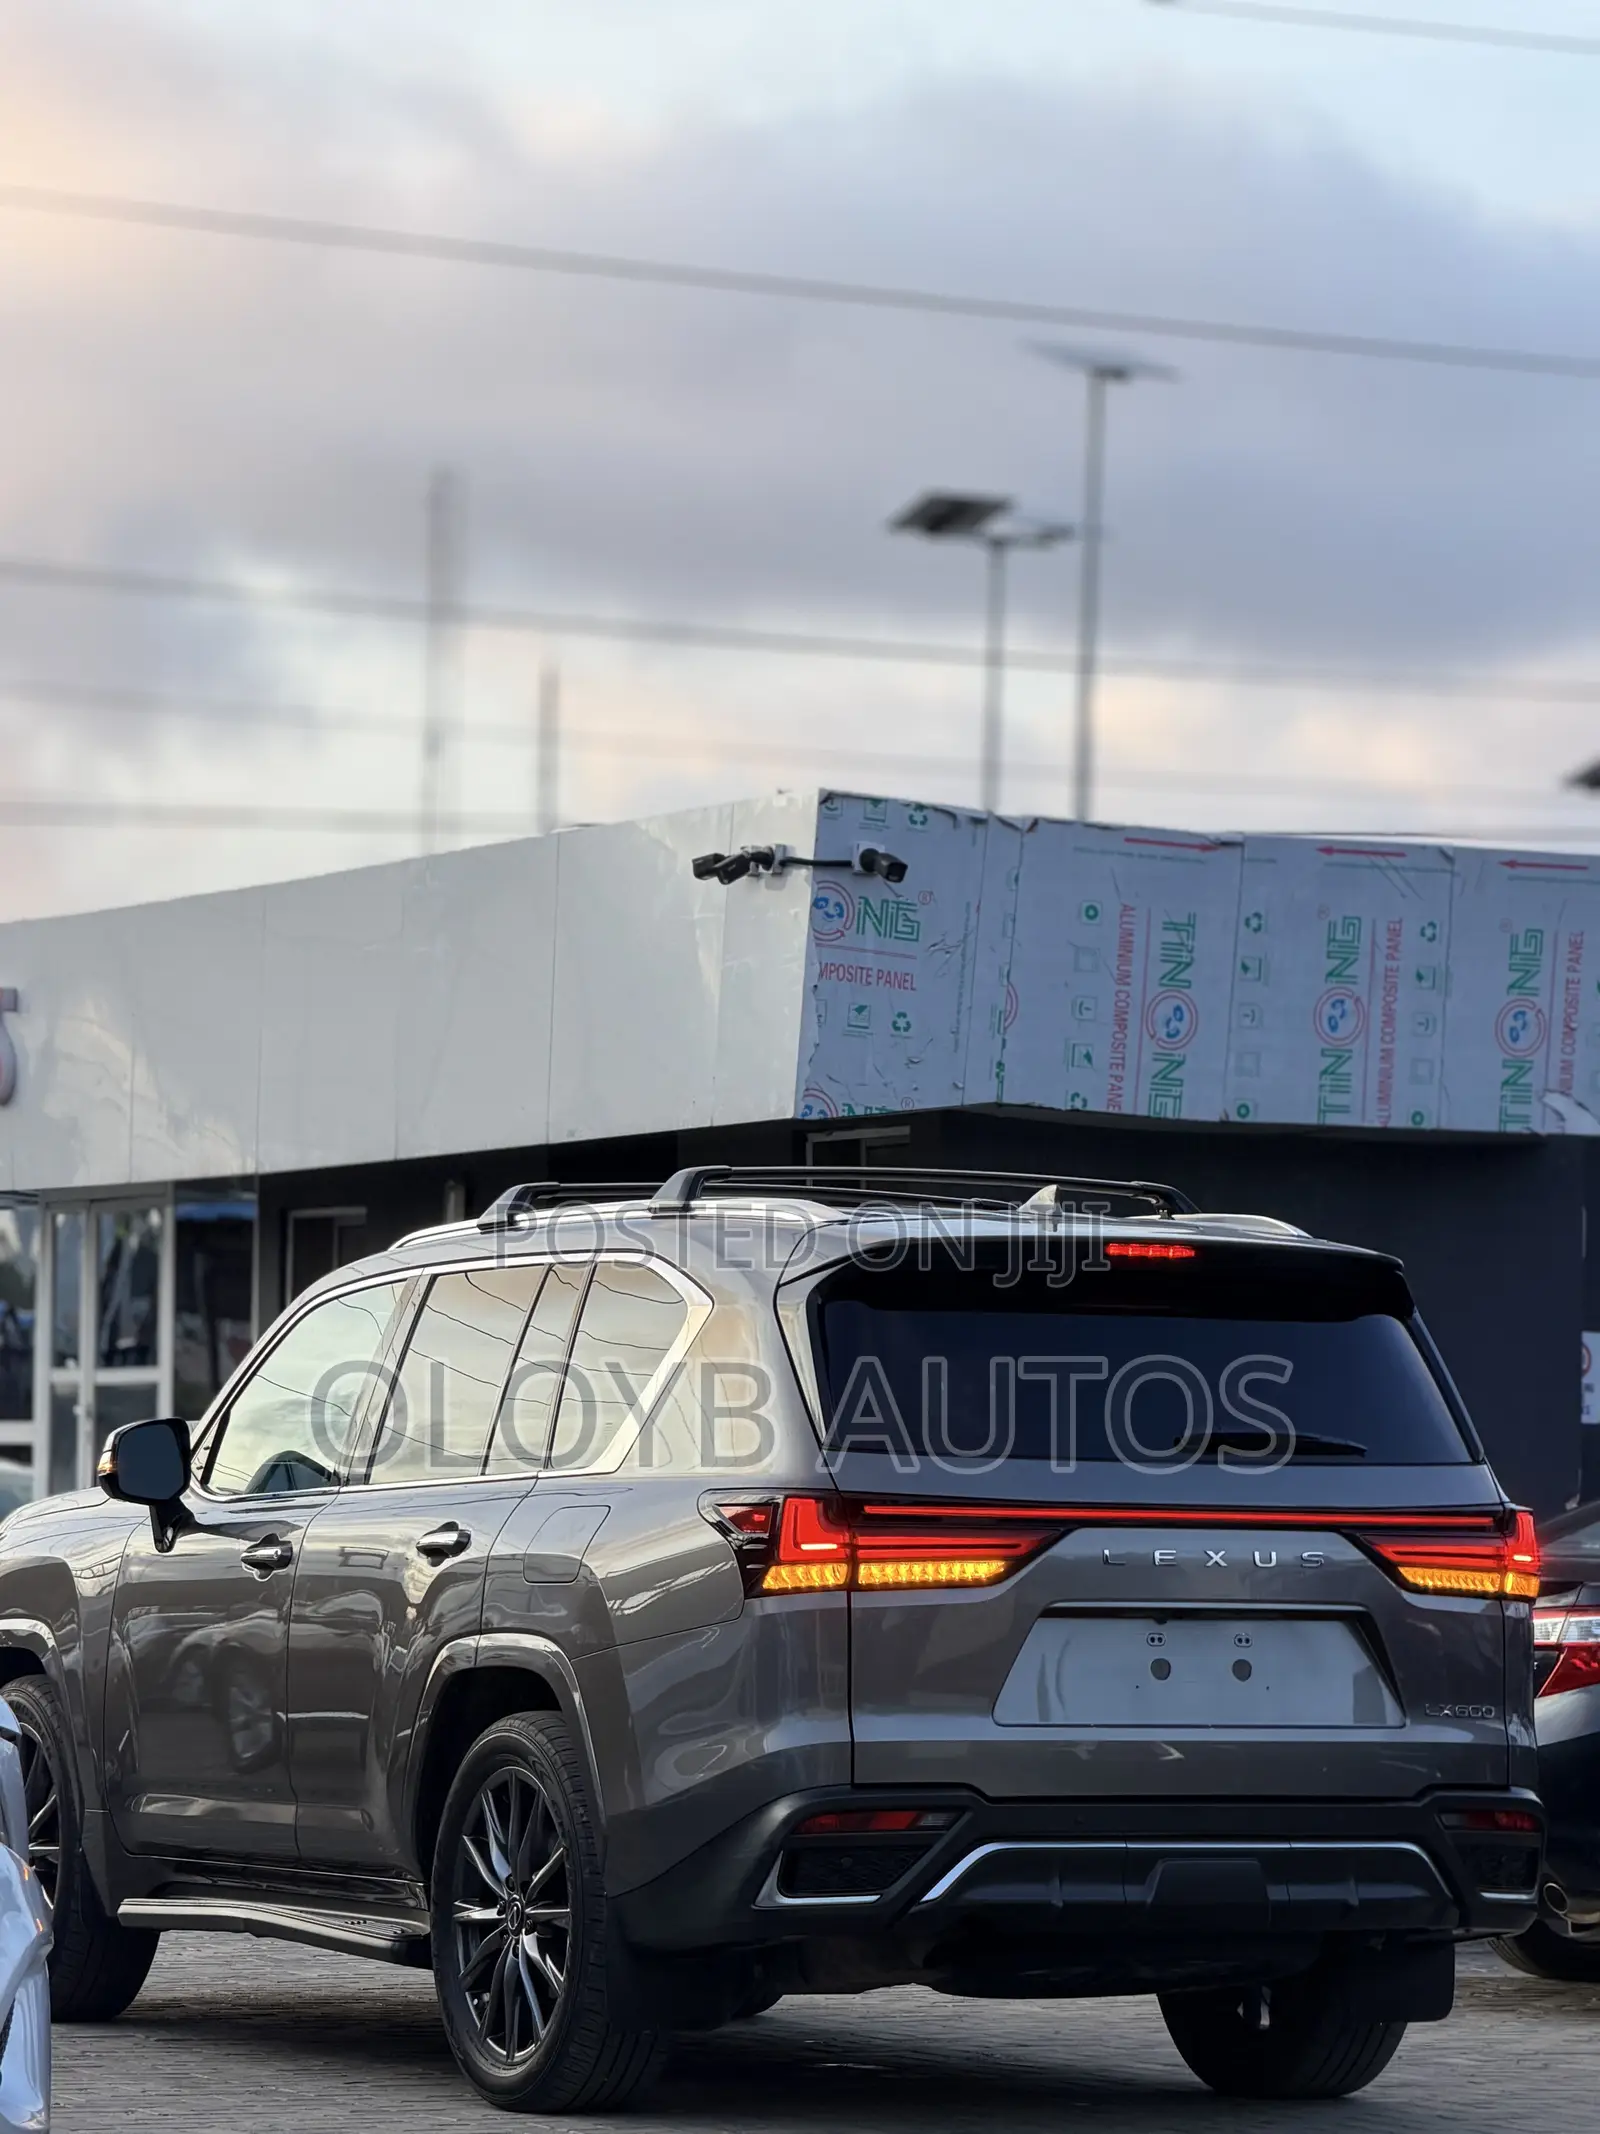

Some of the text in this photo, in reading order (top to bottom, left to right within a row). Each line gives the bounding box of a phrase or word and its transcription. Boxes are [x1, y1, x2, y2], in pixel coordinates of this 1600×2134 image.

[1115, 904, 1137, 986] ALUMINIUM
[1385, 917, 1404, 961] PANEL
[1567, 930, 1585, 974] PANEL
[875, 968, 917, 992] PANEL
[1379, 964, 1399, 1048] COMPOSITE
[1560, 976, 1581, 1056] COMPOSITE
[1108, 989, 1131, 1072] COMPOSITE
[1103, 1549, 1324, 1567] LEXUS
[1425, 1703, 1495, 1718] LX600
